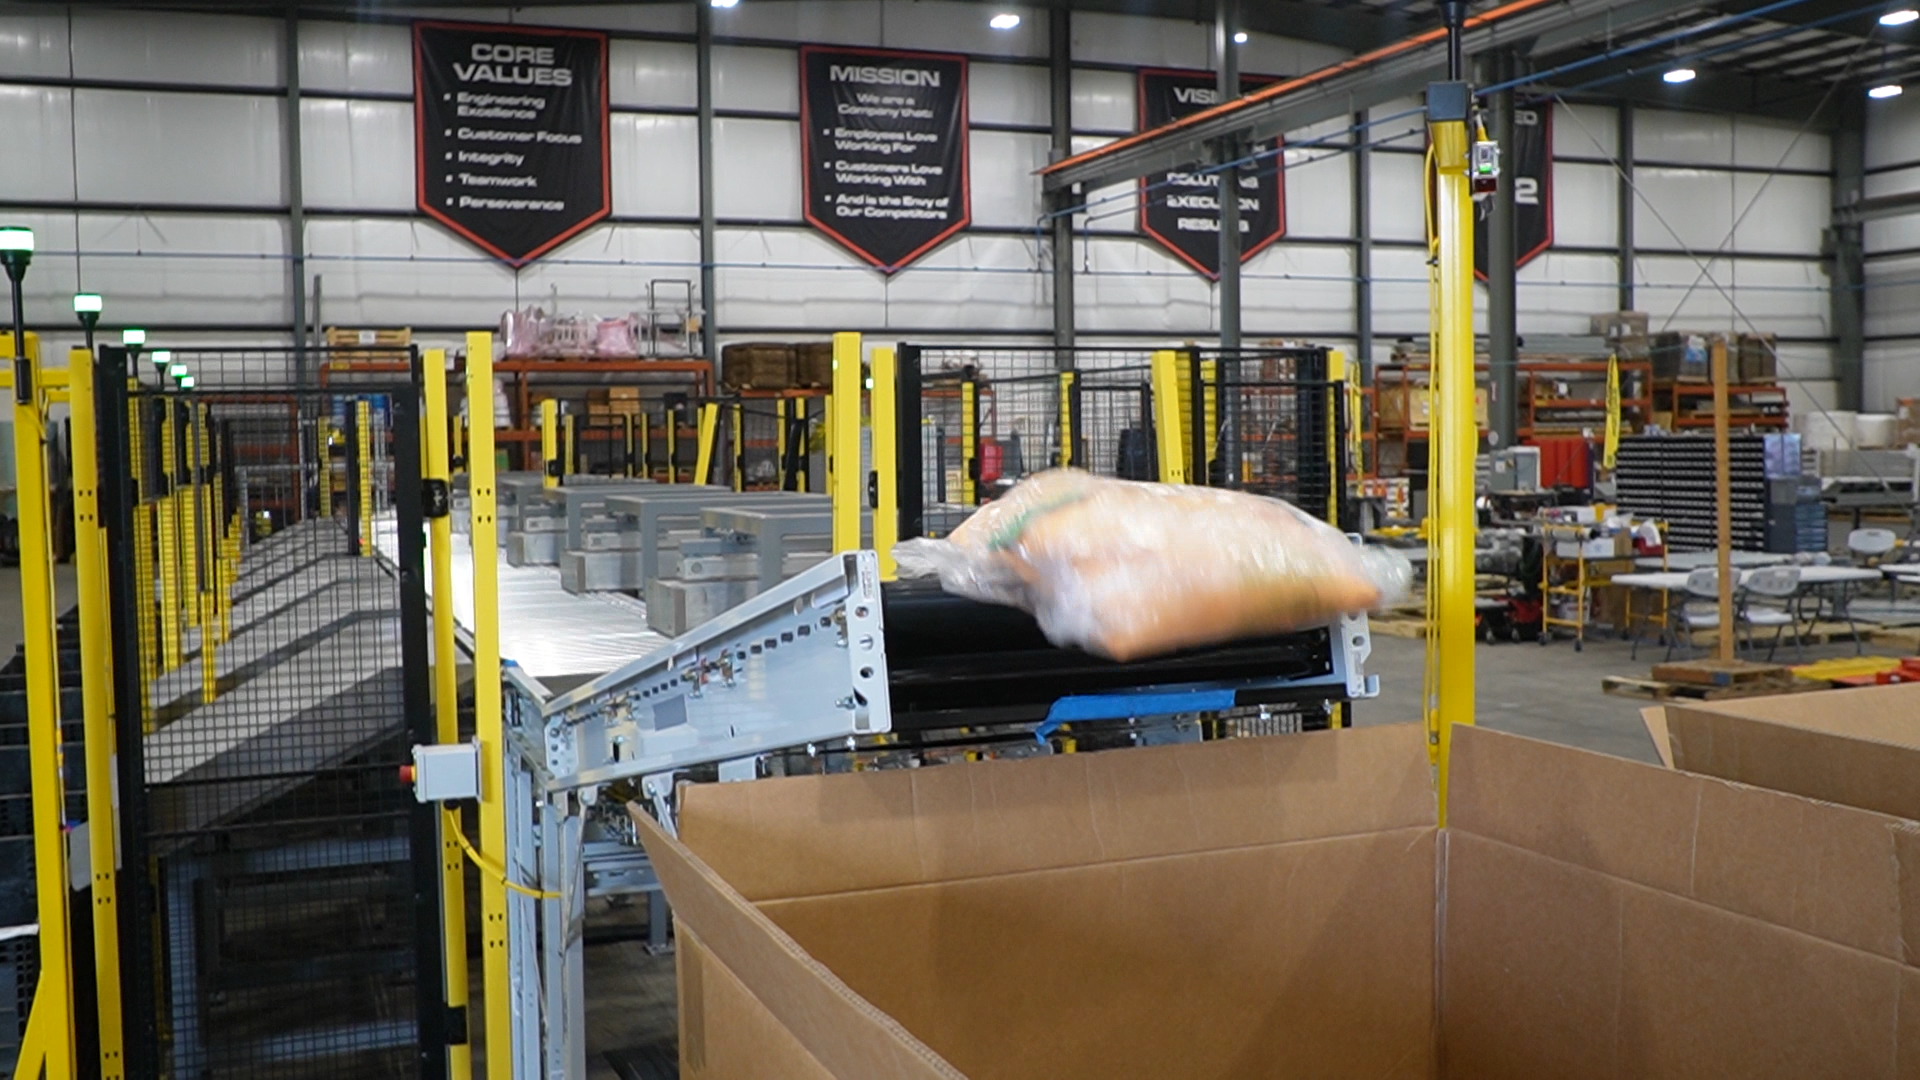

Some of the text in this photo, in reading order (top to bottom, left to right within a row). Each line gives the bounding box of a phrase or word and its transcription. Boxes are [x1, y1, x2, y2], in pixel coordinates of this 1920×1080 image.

[471, 43, 555, 65] CORE
[453, 62, 573, 86] VALUES
[830, 65, 941, 88] MISSION
[457, 92, 546, 110] Engineering
[856, 92, 916, 106] We are a
[457, 105, 537, 119] Excellence
[837, 103, 901, 119] Company
[457, 127, 583, 144] Customer Focus
[834, 127, 938, 142] Employees Love
[834, 140, 917, 155] Working For
[458, 150, 525, 167] Integrity
[835, 160, 943, 175] Customers Love
[459, 173, 538, 188] Teamwork
[835, 173, 927, 187] Working With
[459, 196, 565, 211] Perseverance
[836, 194, 950, 209] And is the Envy of
[836, 206, 948, 219] Our Competitors
[1177, 217, 1250, 233] RESUS
